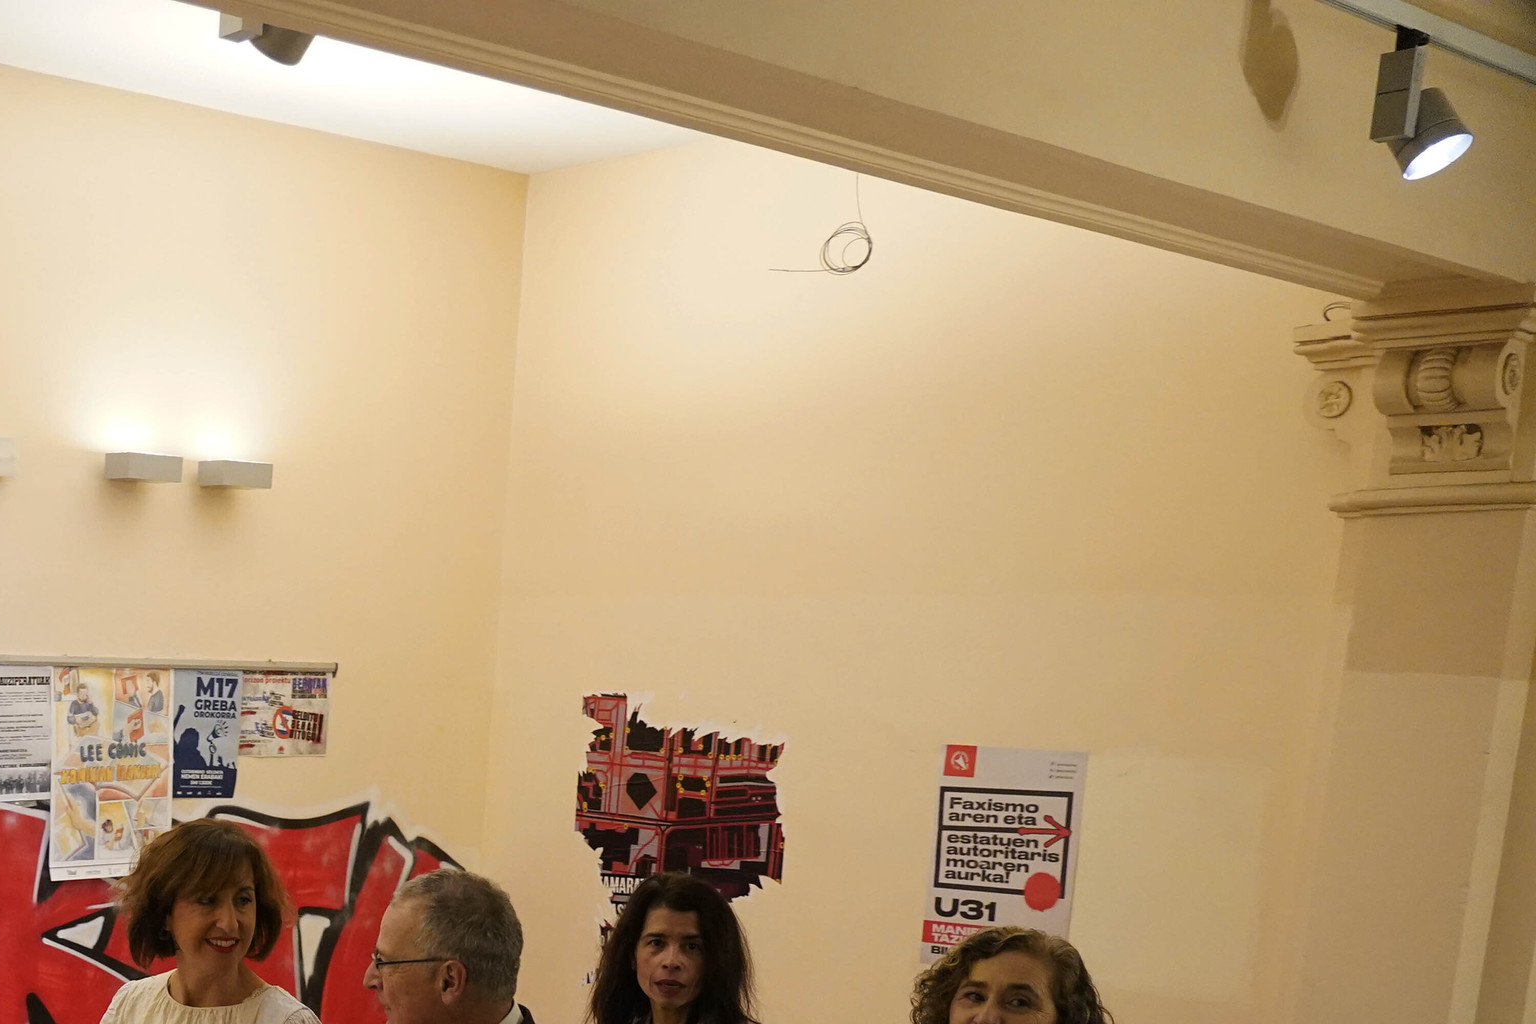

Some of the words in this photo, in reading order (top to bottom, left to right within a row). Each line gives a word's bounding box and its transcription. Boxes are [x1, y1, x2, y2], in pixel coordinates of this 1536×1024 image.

[196, 676, 238, 698] M17
[195, 699, 237, 711] GREBA
[194, 711, 236, 719] OROKORRA
[80, 744, 104, 762] LEE
[949, 797, 1039, 814] Faxismo
[948, 813, 998, 824] aren
[1004, 813, 1037, 825] eta
[947, 833, 1039, 849] estatuen
[946, 845, 1060, 863] autoritaris
[945, 858, 1029, 873] moaren
[944, 869, 1011, 884] aurka!
[934, 897, 998, 922] U31
